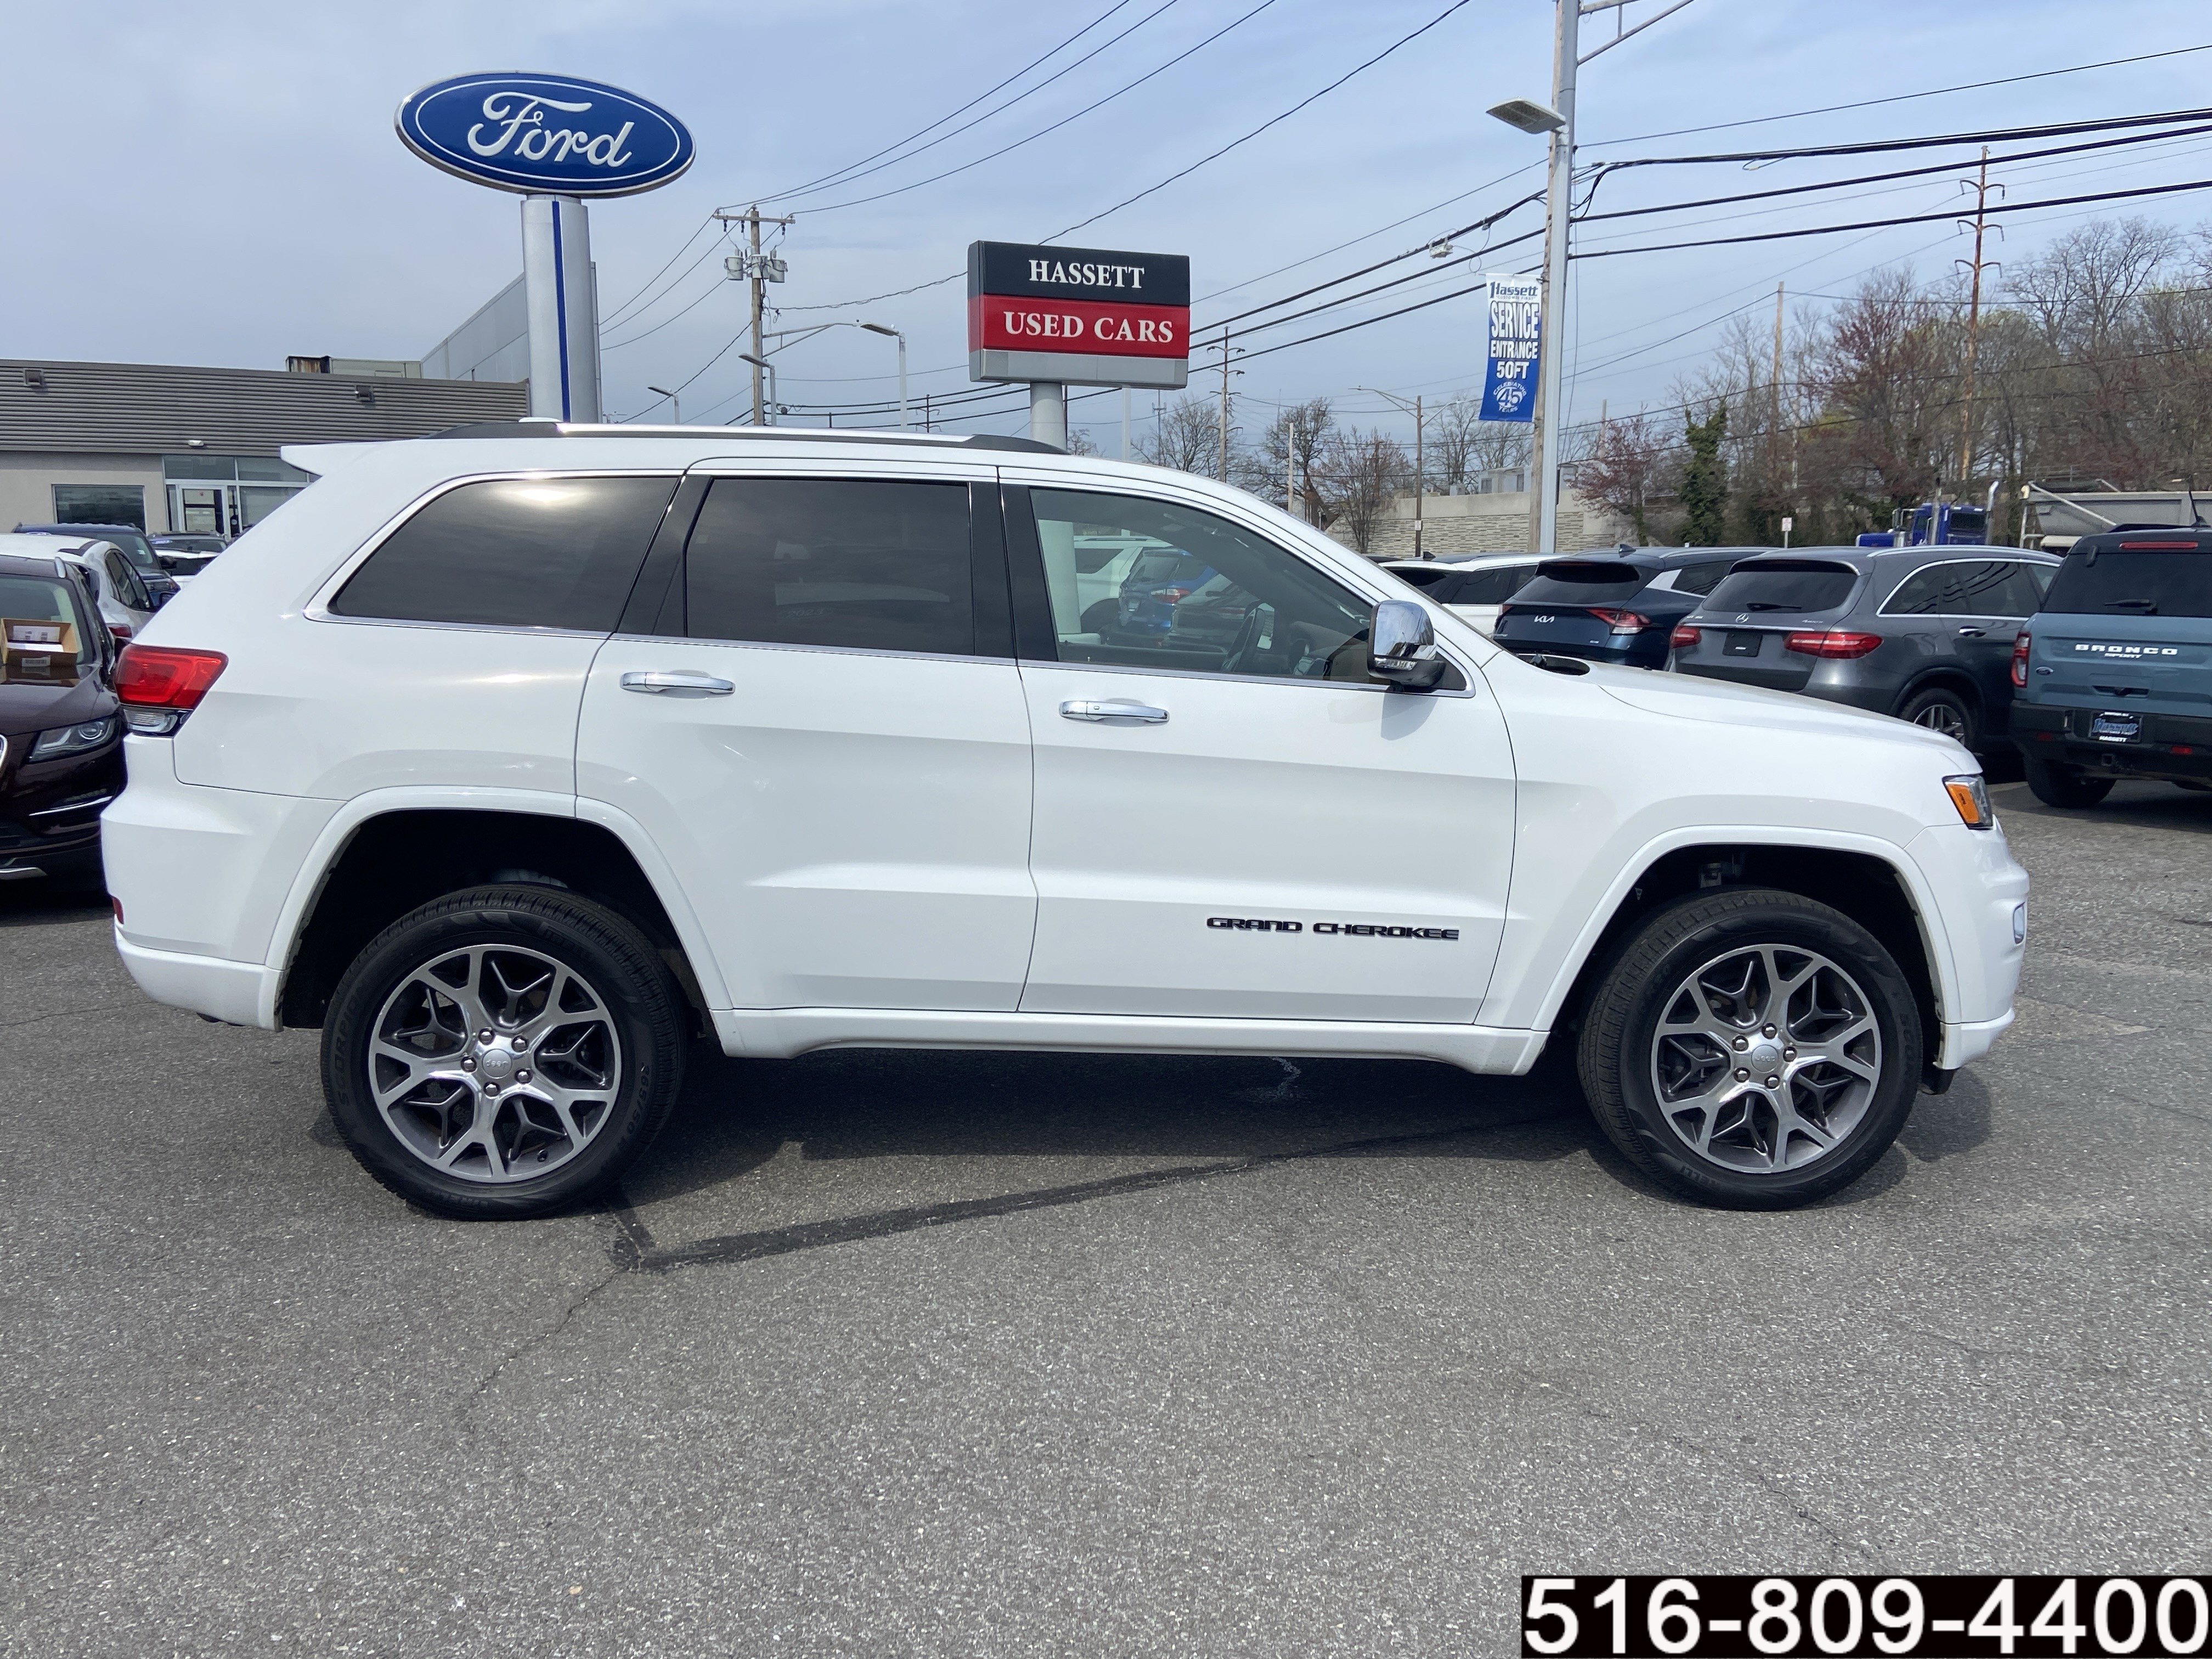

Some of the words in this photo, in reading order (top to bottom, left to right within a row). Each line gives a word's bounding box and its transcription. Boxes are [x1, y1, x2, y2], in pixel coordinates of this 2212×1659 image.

[467, 91, 635, 167] Ford
[1029, 259, 1145, 289] HASSETT
[1490, 281, 1538, 298] Hassett
[1003, 311, 1084, 338] USED
[1094, 317, 1173, 343] CARS
[1490, 301, 1539, 339] SERVICE
[1490, 340, 1538, 359] ENTRANCE
[1496, 360, 1530, 379] 50FT
[1498, 388, 1520, 406] 45
[2075, 644, 2178, 656] BRONCO
[1206, 917, 1303, 932] GRAND
[1313, 922, 1459, 940] CHEROKEE
